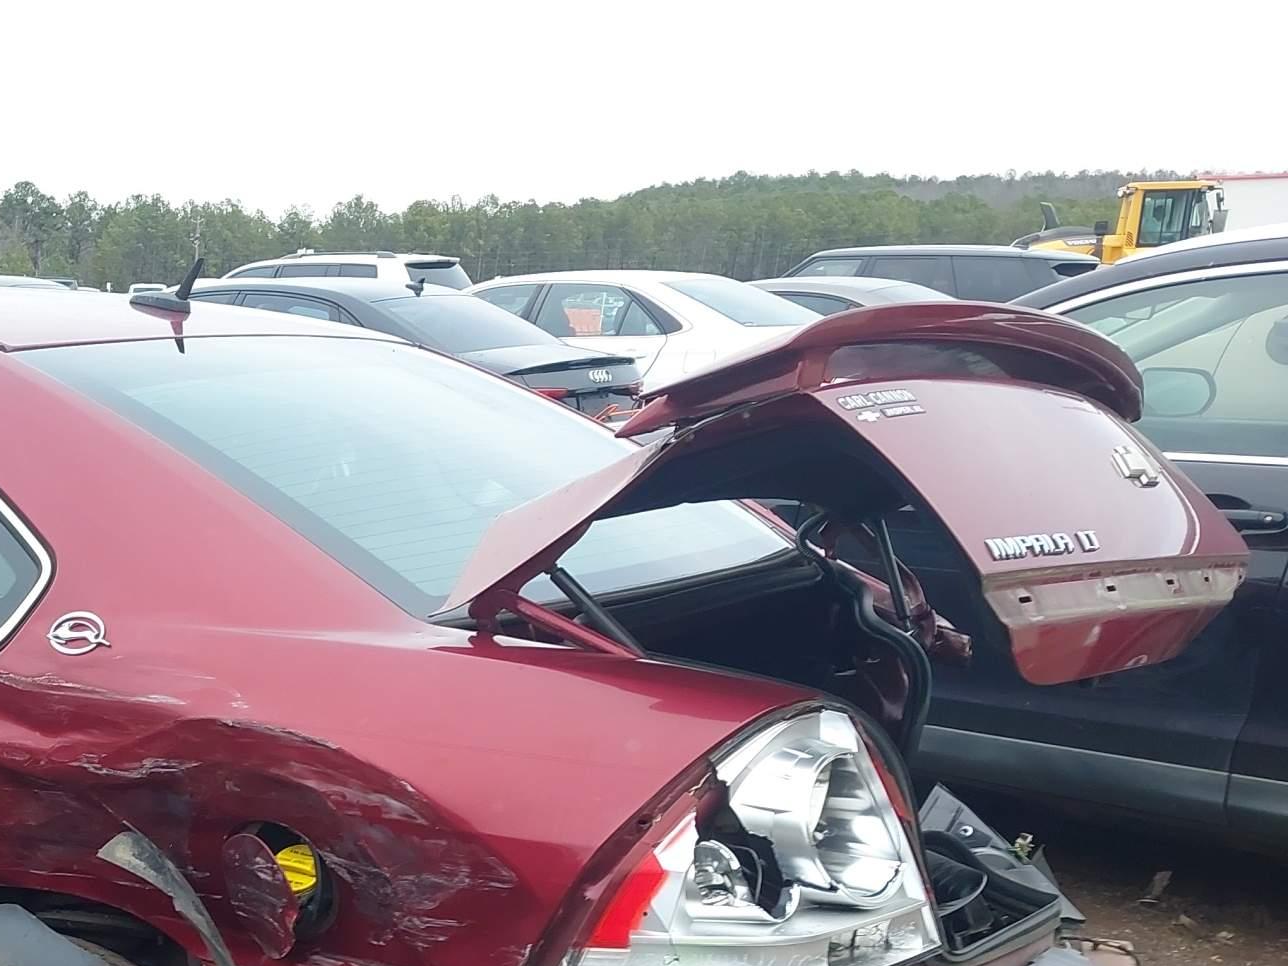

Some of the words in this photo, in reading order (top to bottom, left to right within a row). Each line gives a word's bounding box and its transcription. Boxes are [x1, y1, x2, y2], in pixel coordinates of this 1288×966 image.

[836, 393, 874, 411] CARL
[868, 388, 918, 405] CANNON
[983, 533, 1075, 561] IMPALA
[1074, 530, 1101, 553] LT
